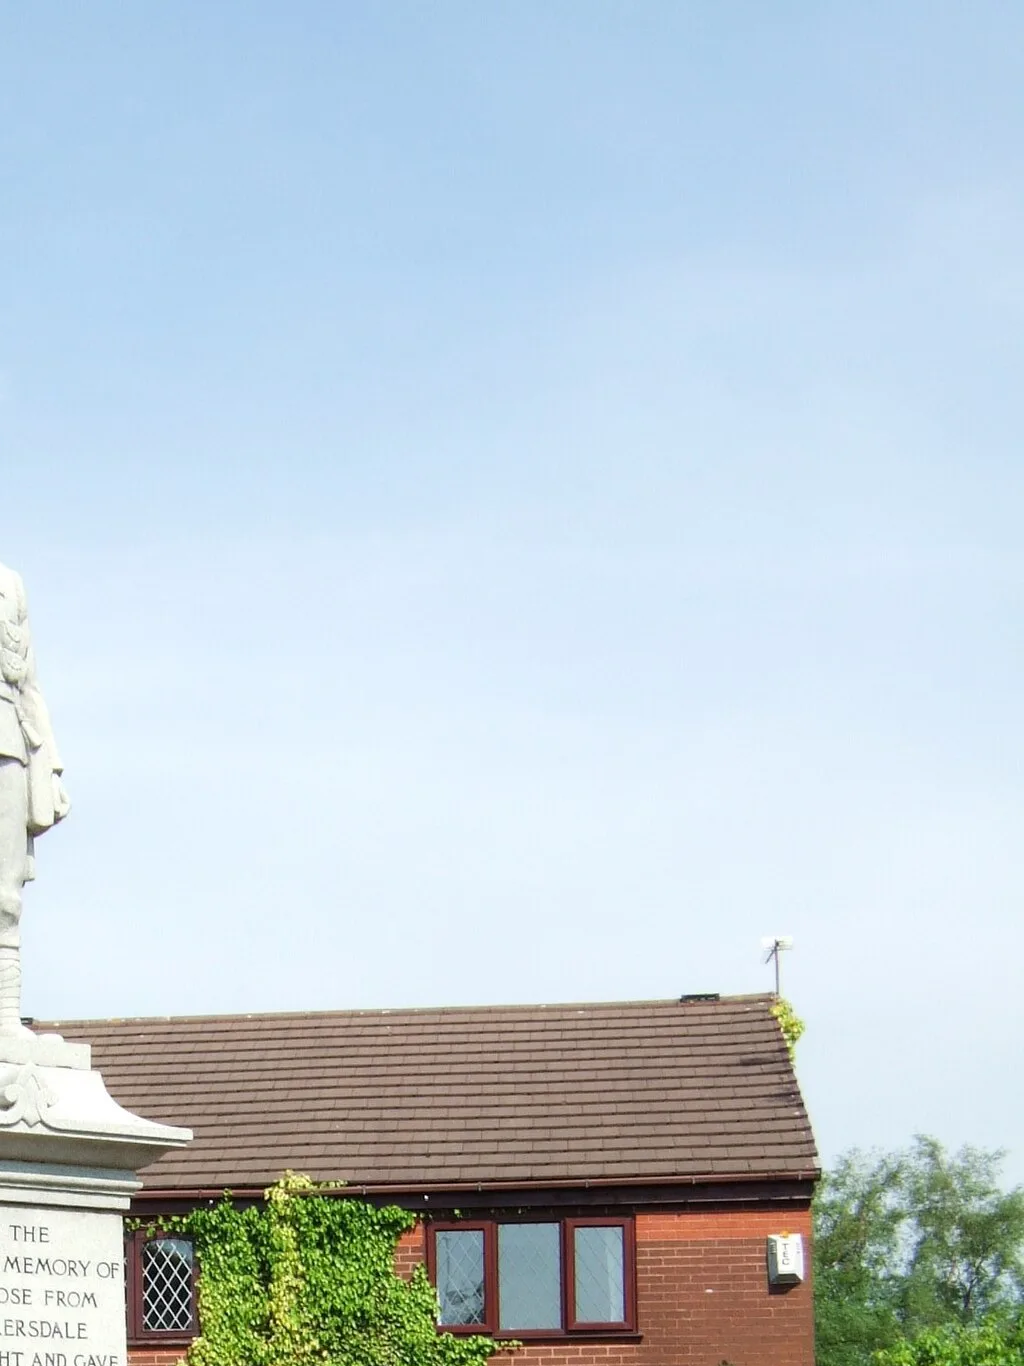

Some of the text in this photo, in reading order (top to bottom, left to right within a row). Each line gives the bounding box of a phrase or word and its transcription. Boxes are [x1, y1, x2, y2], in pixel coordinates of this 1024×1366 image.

[9, 1225, 50, 1242] THE
[4, 1256, 90, 1276] MEMORY
[96, 1262, 119, 1278] OF
[45, 1290, 97, 1308] FROM
